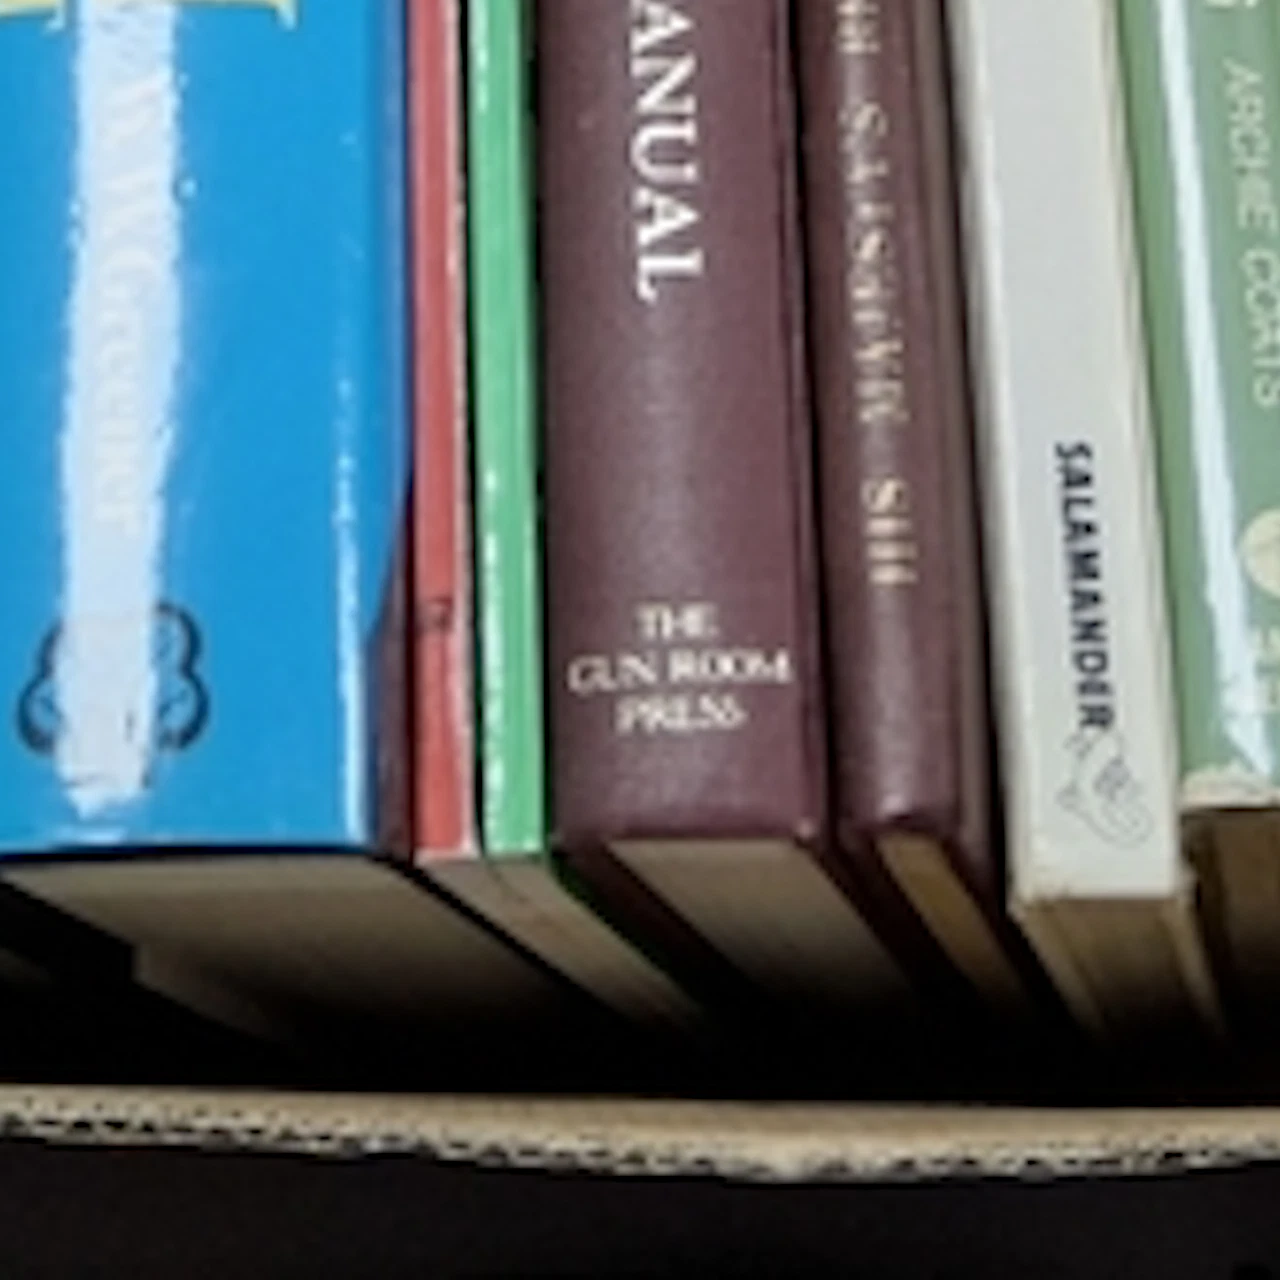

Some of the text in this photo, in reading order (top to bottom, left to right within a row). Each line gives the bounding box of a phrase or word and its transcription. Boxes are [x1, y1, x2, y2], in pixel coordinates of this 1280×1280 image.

[1221, 57, 1280, 231] ARCHIE
[1055, 440, 1115, 732] SALAMANDER
[636, 601, 719, 641] THE
[567, 646, 794, 695] GUN ROOM
[616, 692, 749, 734] PRESS
